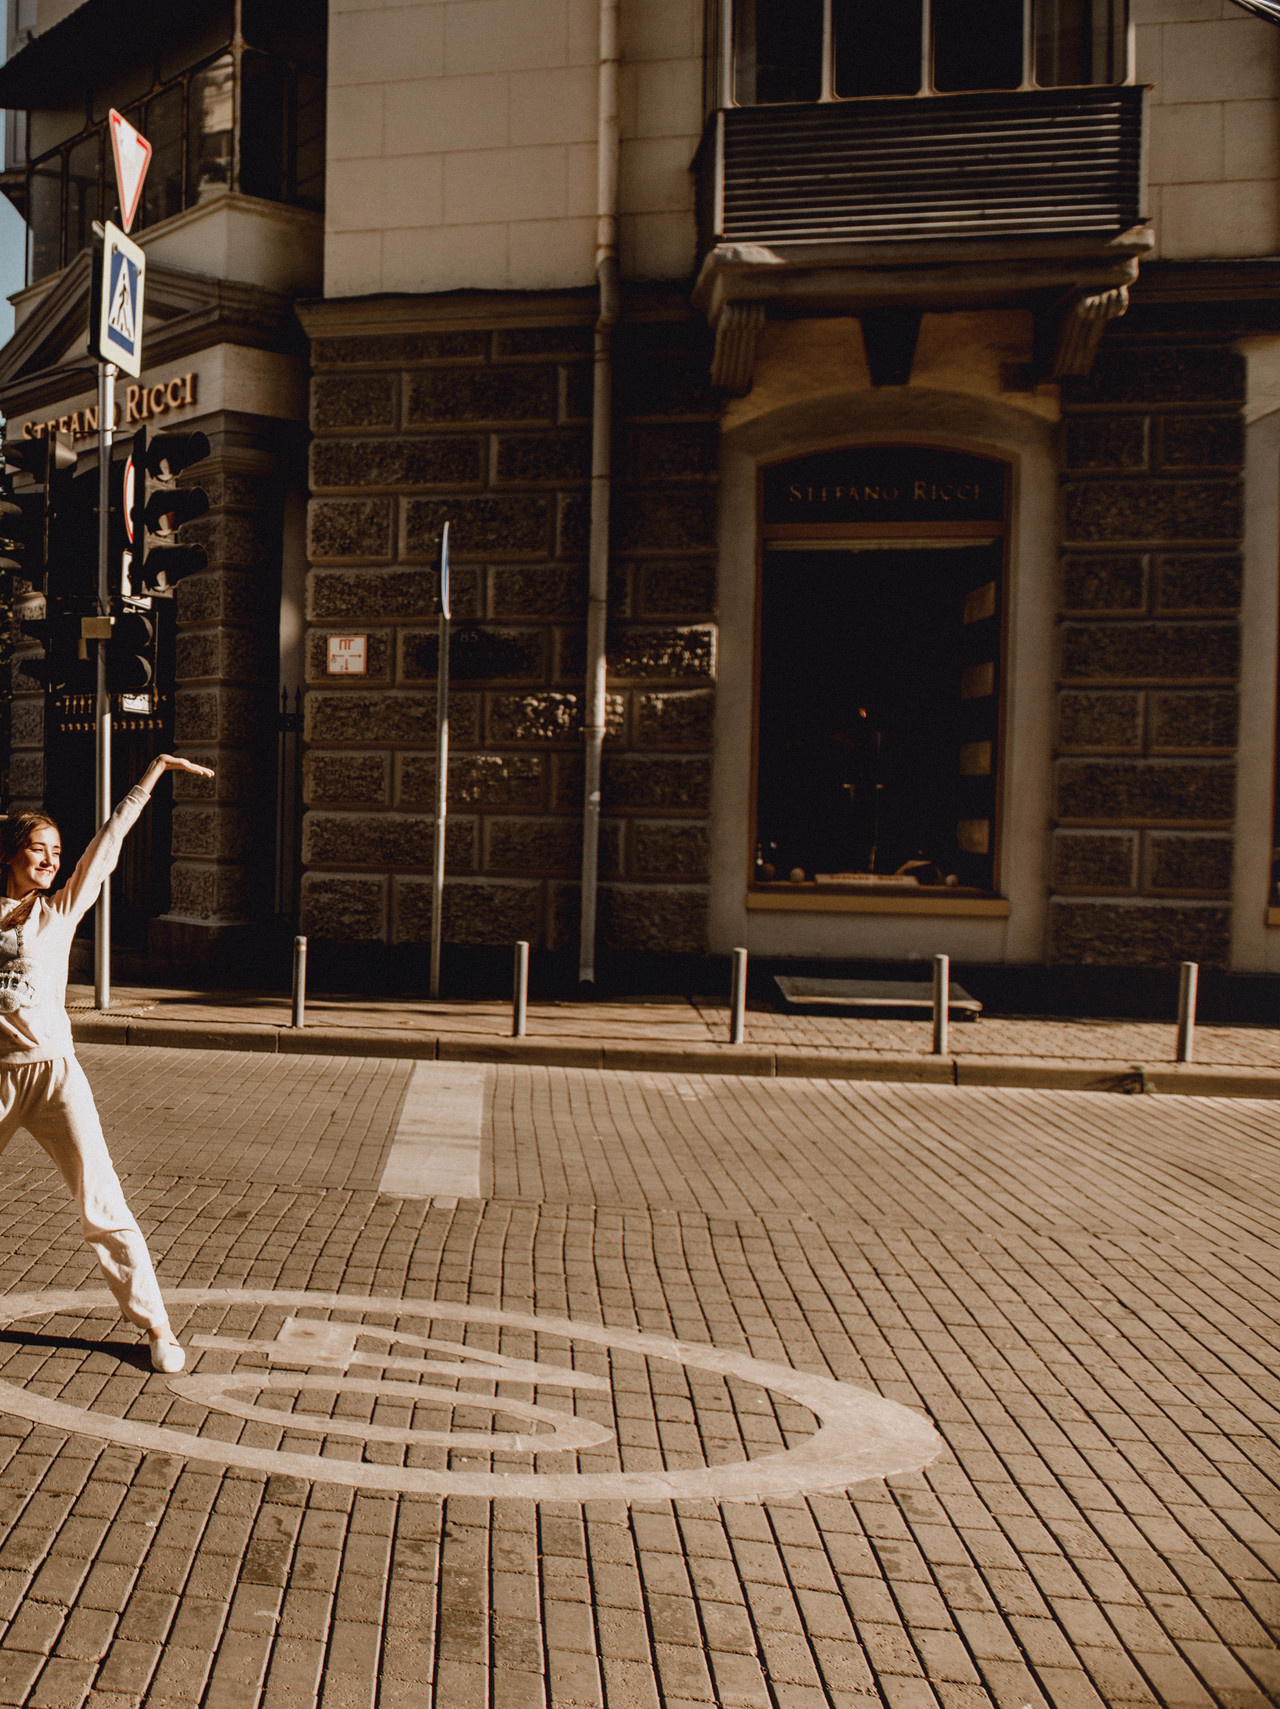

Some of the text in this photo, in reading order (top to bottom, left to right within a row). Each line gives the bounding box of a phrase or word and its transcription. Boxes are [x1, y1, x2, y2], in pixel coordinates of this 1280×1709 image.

[126, 372, 197, 424] RICCI
[788, 480, 981, 502] STEFANO RICCI
[339, 639, 355, 650] ПГ
